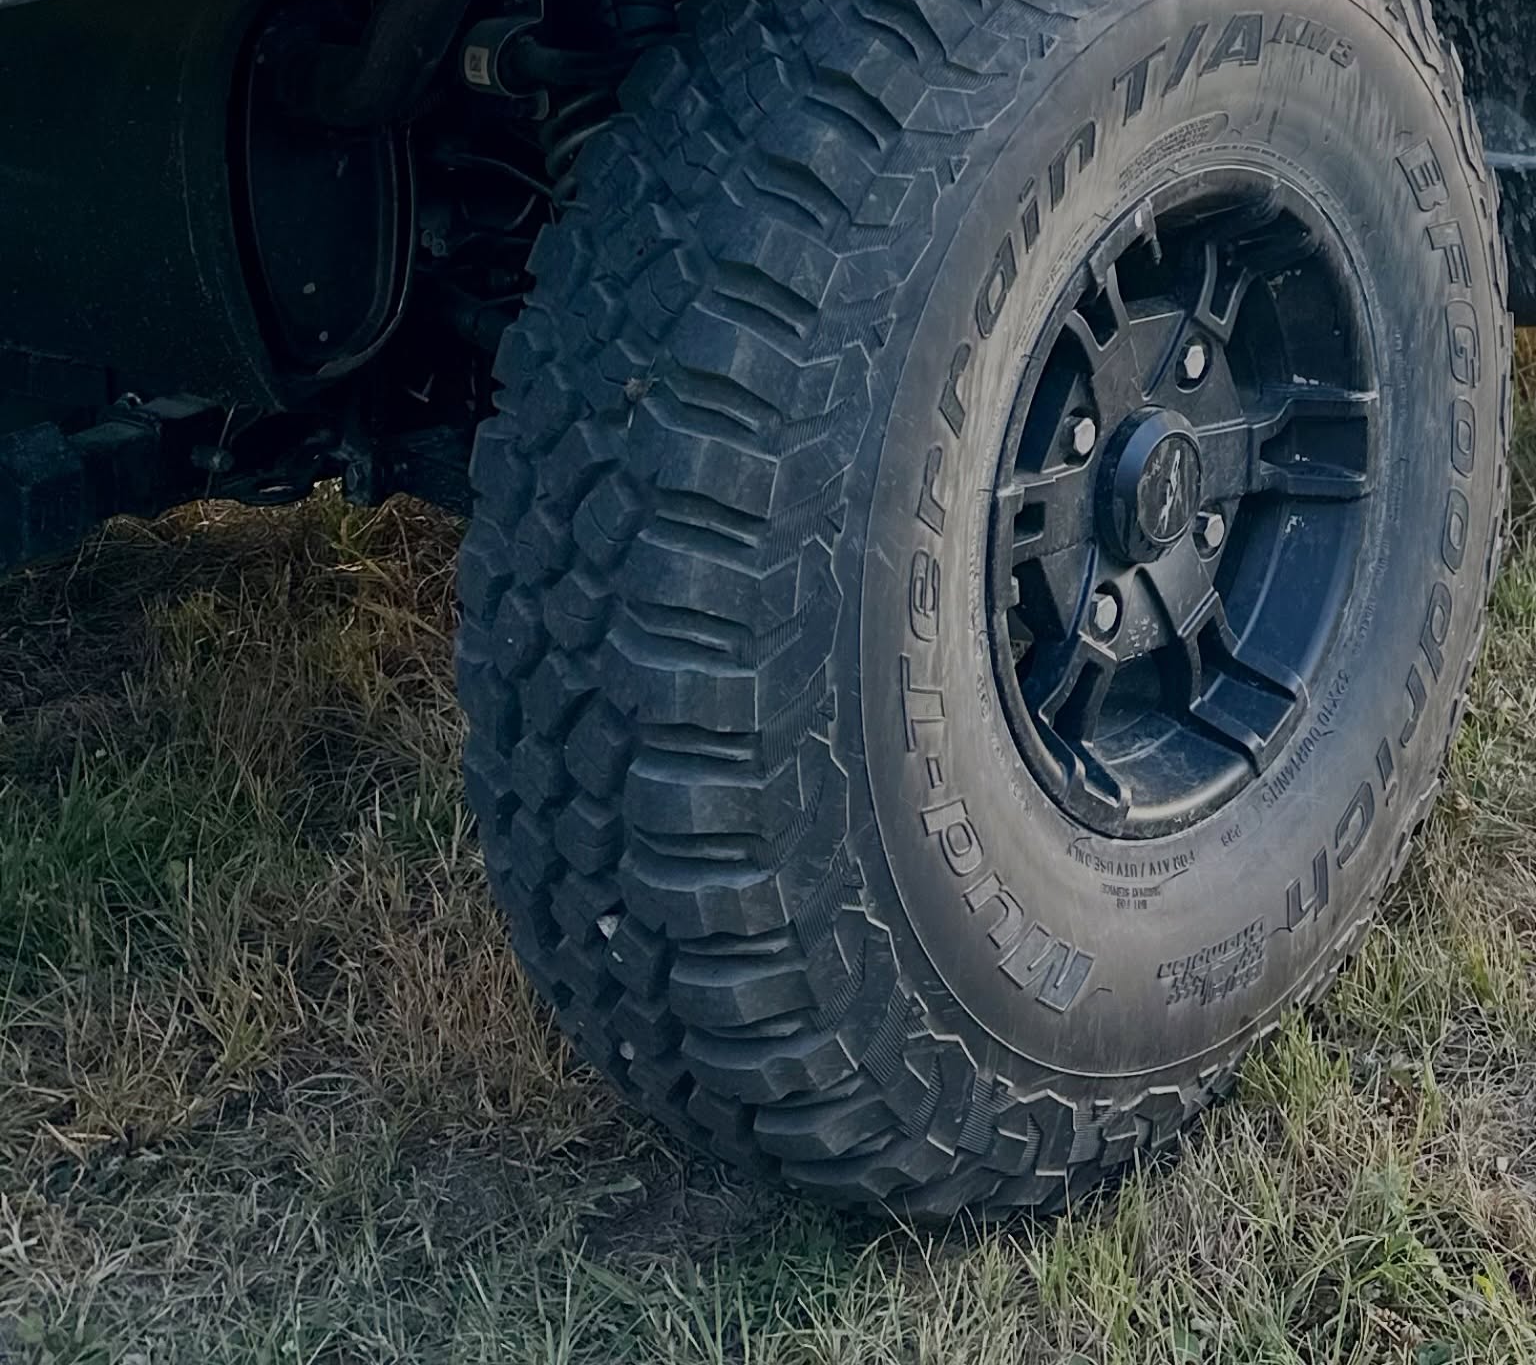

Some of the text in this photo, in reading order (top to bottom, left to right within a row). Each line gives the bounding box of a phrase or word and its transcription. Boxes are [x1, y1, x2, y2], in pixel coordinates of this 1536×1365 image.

[1112, 11, 1264, 126] T/A
[1264, 13, 1353, 70] KM3
[1066, 842, 1093, 869] ONLY
[1094, 854, 1114, 875] USE
[1116, 860, 1139, 878] UTV
[1149, 859, 1170, 877] ATV
